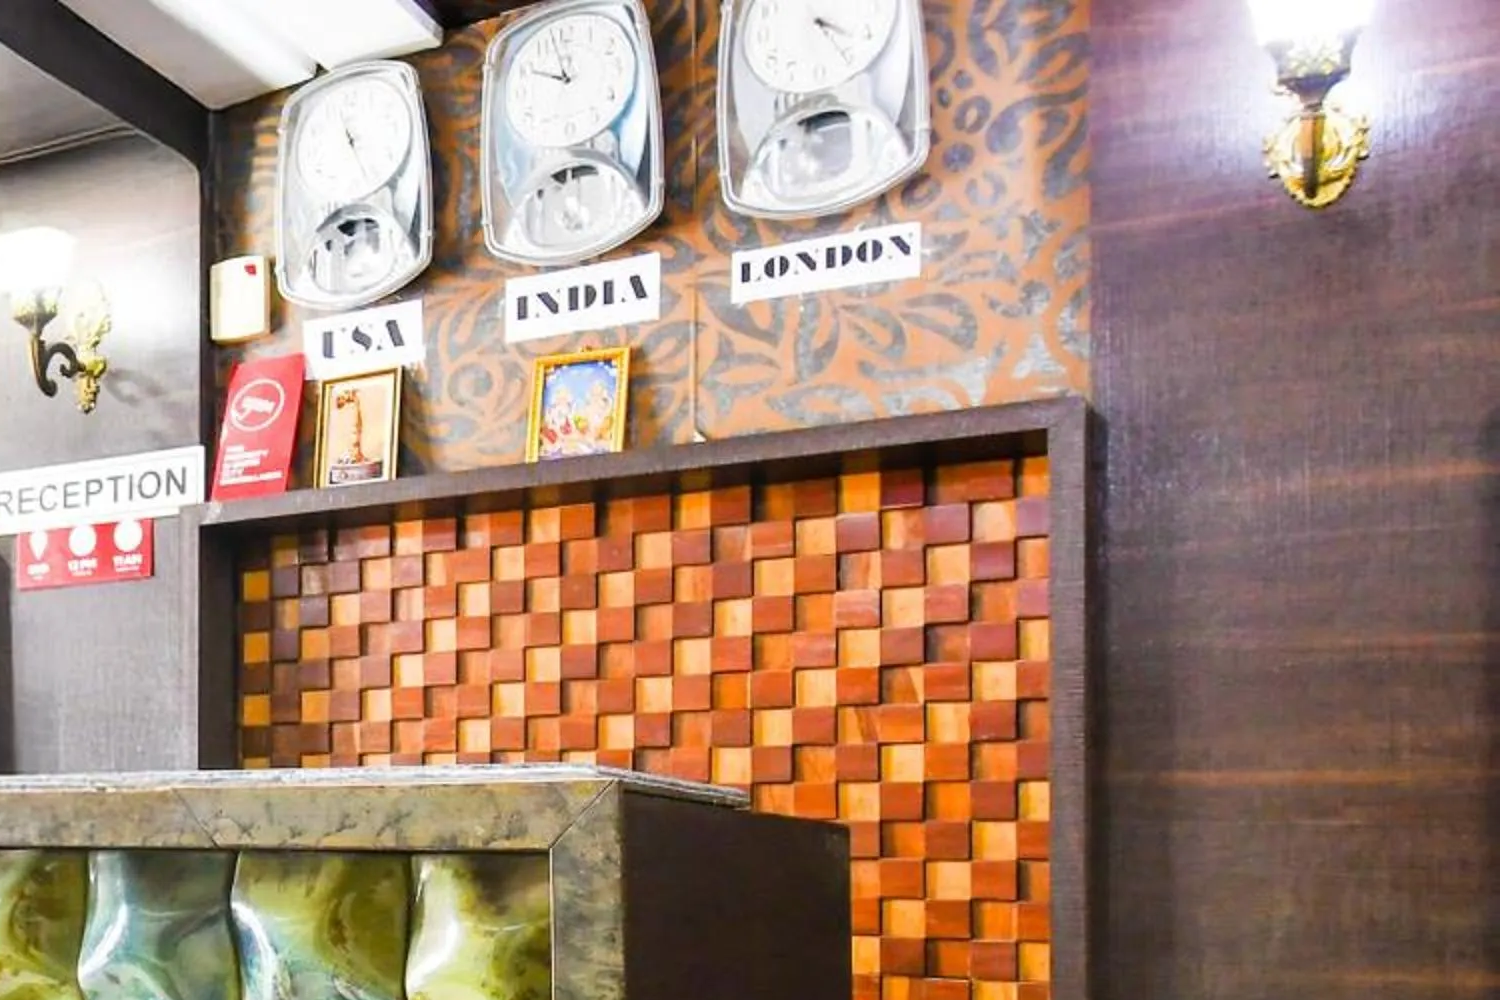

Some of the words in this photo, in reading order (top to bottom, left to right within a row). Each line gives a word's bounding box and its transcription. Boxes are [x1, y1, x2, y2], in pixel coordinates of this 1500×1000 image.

[741, 232, 913, 283] LONDON
[516, 273, 649, 321] INDIA
[322, 318, 405, 360] USA
